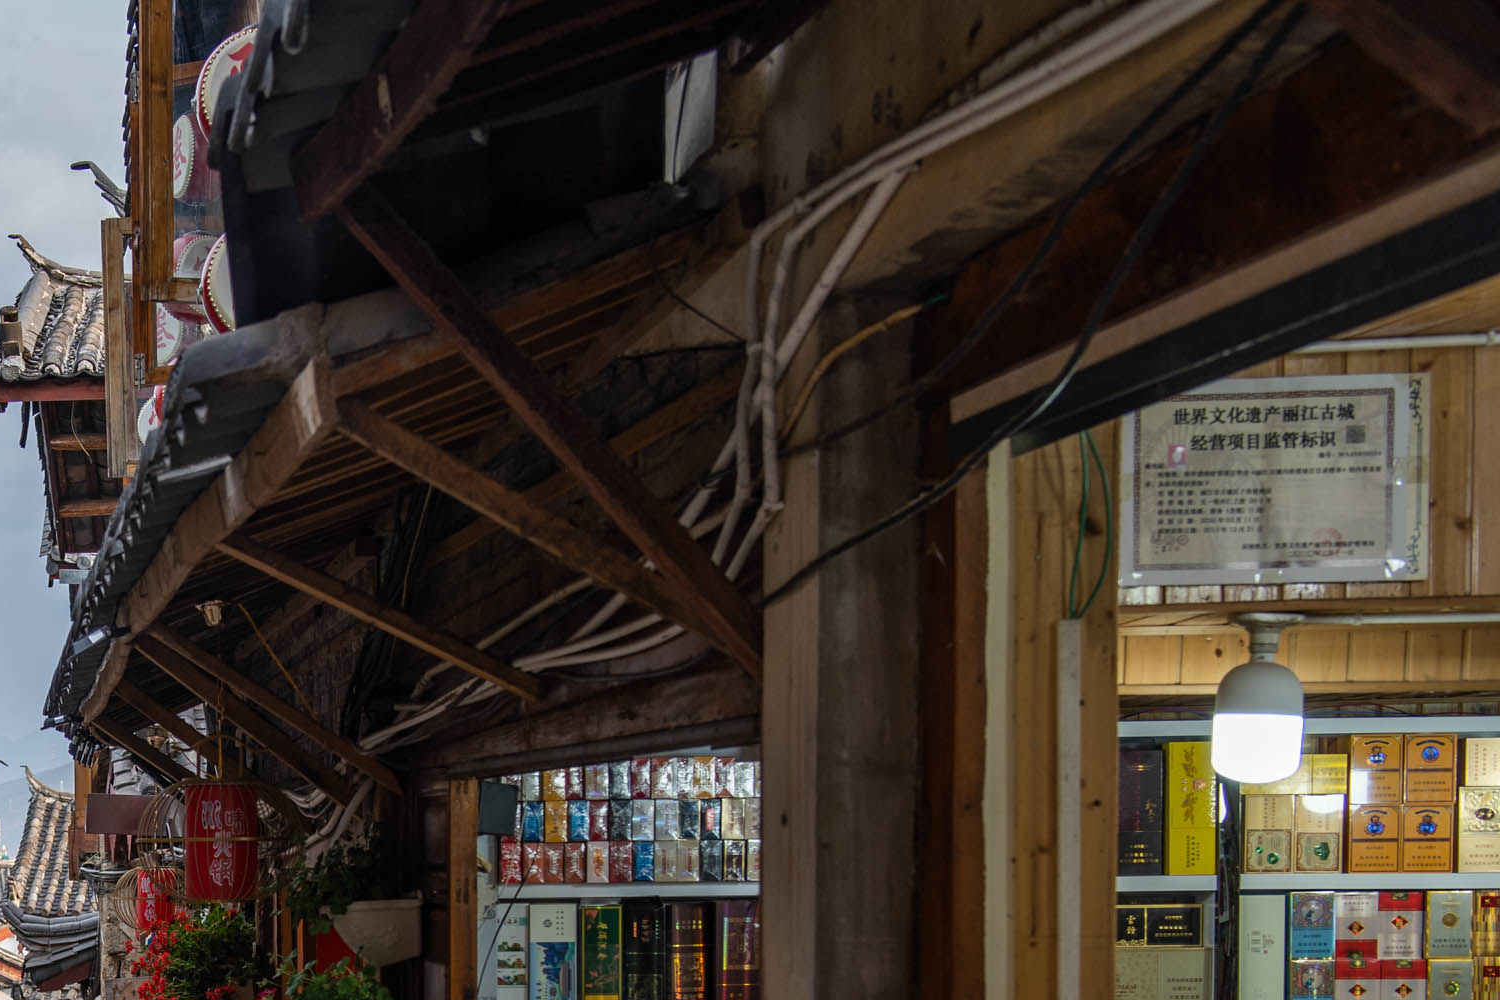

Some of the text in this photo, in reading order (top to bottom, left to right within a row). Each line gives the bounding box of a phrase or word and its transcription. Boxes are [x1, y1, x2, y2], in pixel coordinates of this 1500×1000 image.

[1173, 402, 1355, 426] 世界文化遗产丽江古城
[1189, 431, 1336, 451] 经营项目监管标识
